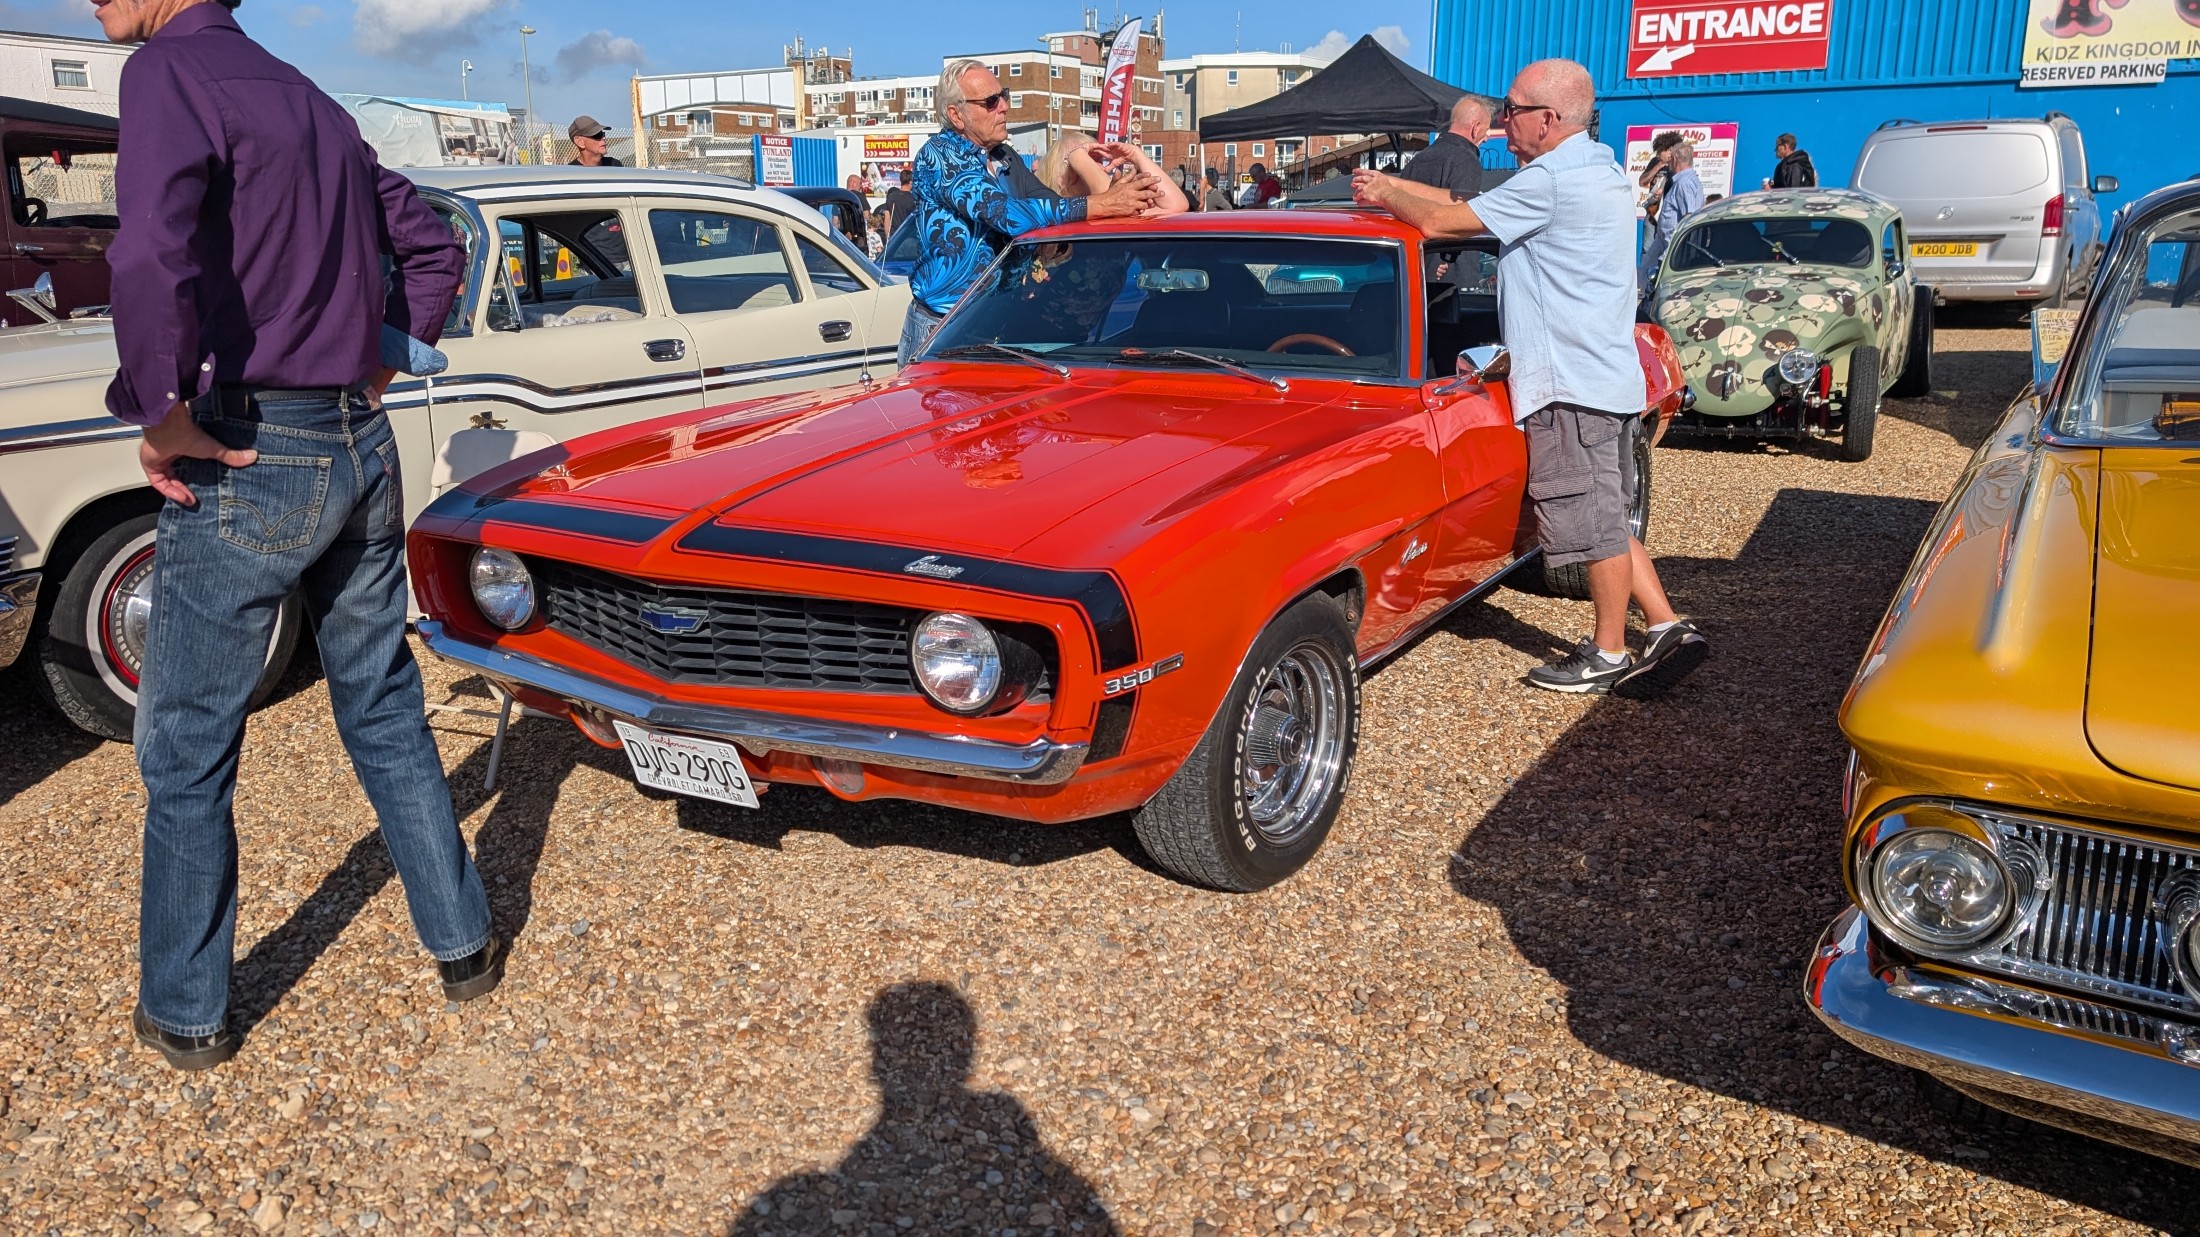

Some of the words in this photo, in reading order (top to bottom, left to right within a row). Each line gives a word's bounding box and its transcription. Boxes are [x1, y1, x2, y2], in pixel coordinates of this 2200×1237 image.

[1638, 2, 1825, 43] ENTRANCE
[2036, 45, 2081, 62] KIDZ
[2085, 40, 2181, 60] KINGDOM
[2022, 66, 2096, 82] RESERVED
[2100, 63, 2166, 79] PARKING
[1104, 72, 1127, 144] WHEE
[765, 137, 788, 146] NOTICE
[865, 141, 909, 150] ENTRANCE
[762, 147, 792, 157] FUNLAND
[1697, 150, 1724, 158] NOTICE
[1629, 164, 1648, 172] ARCA
[1916, 244, 1947, 255] W200
[1949, 244, 1973, 255] JDB
[1104, 667, 1153, 695] 350
[1346, 653, 1362, 744] Radial
[620, 726, 632, 737] 19
[647, 732, 706, 754] California
[718, 747, 731, 759] 69
[624, 738, 682, 777] DVG
[677, 750, 746, 791] 290G
[1233, 666, 1267, 852] BFGoodrich
[647, 772, 691, 790] CHEVROLET
[692, 780, 726, 798] CAMARO
[728, 787, 744, 803] 350
